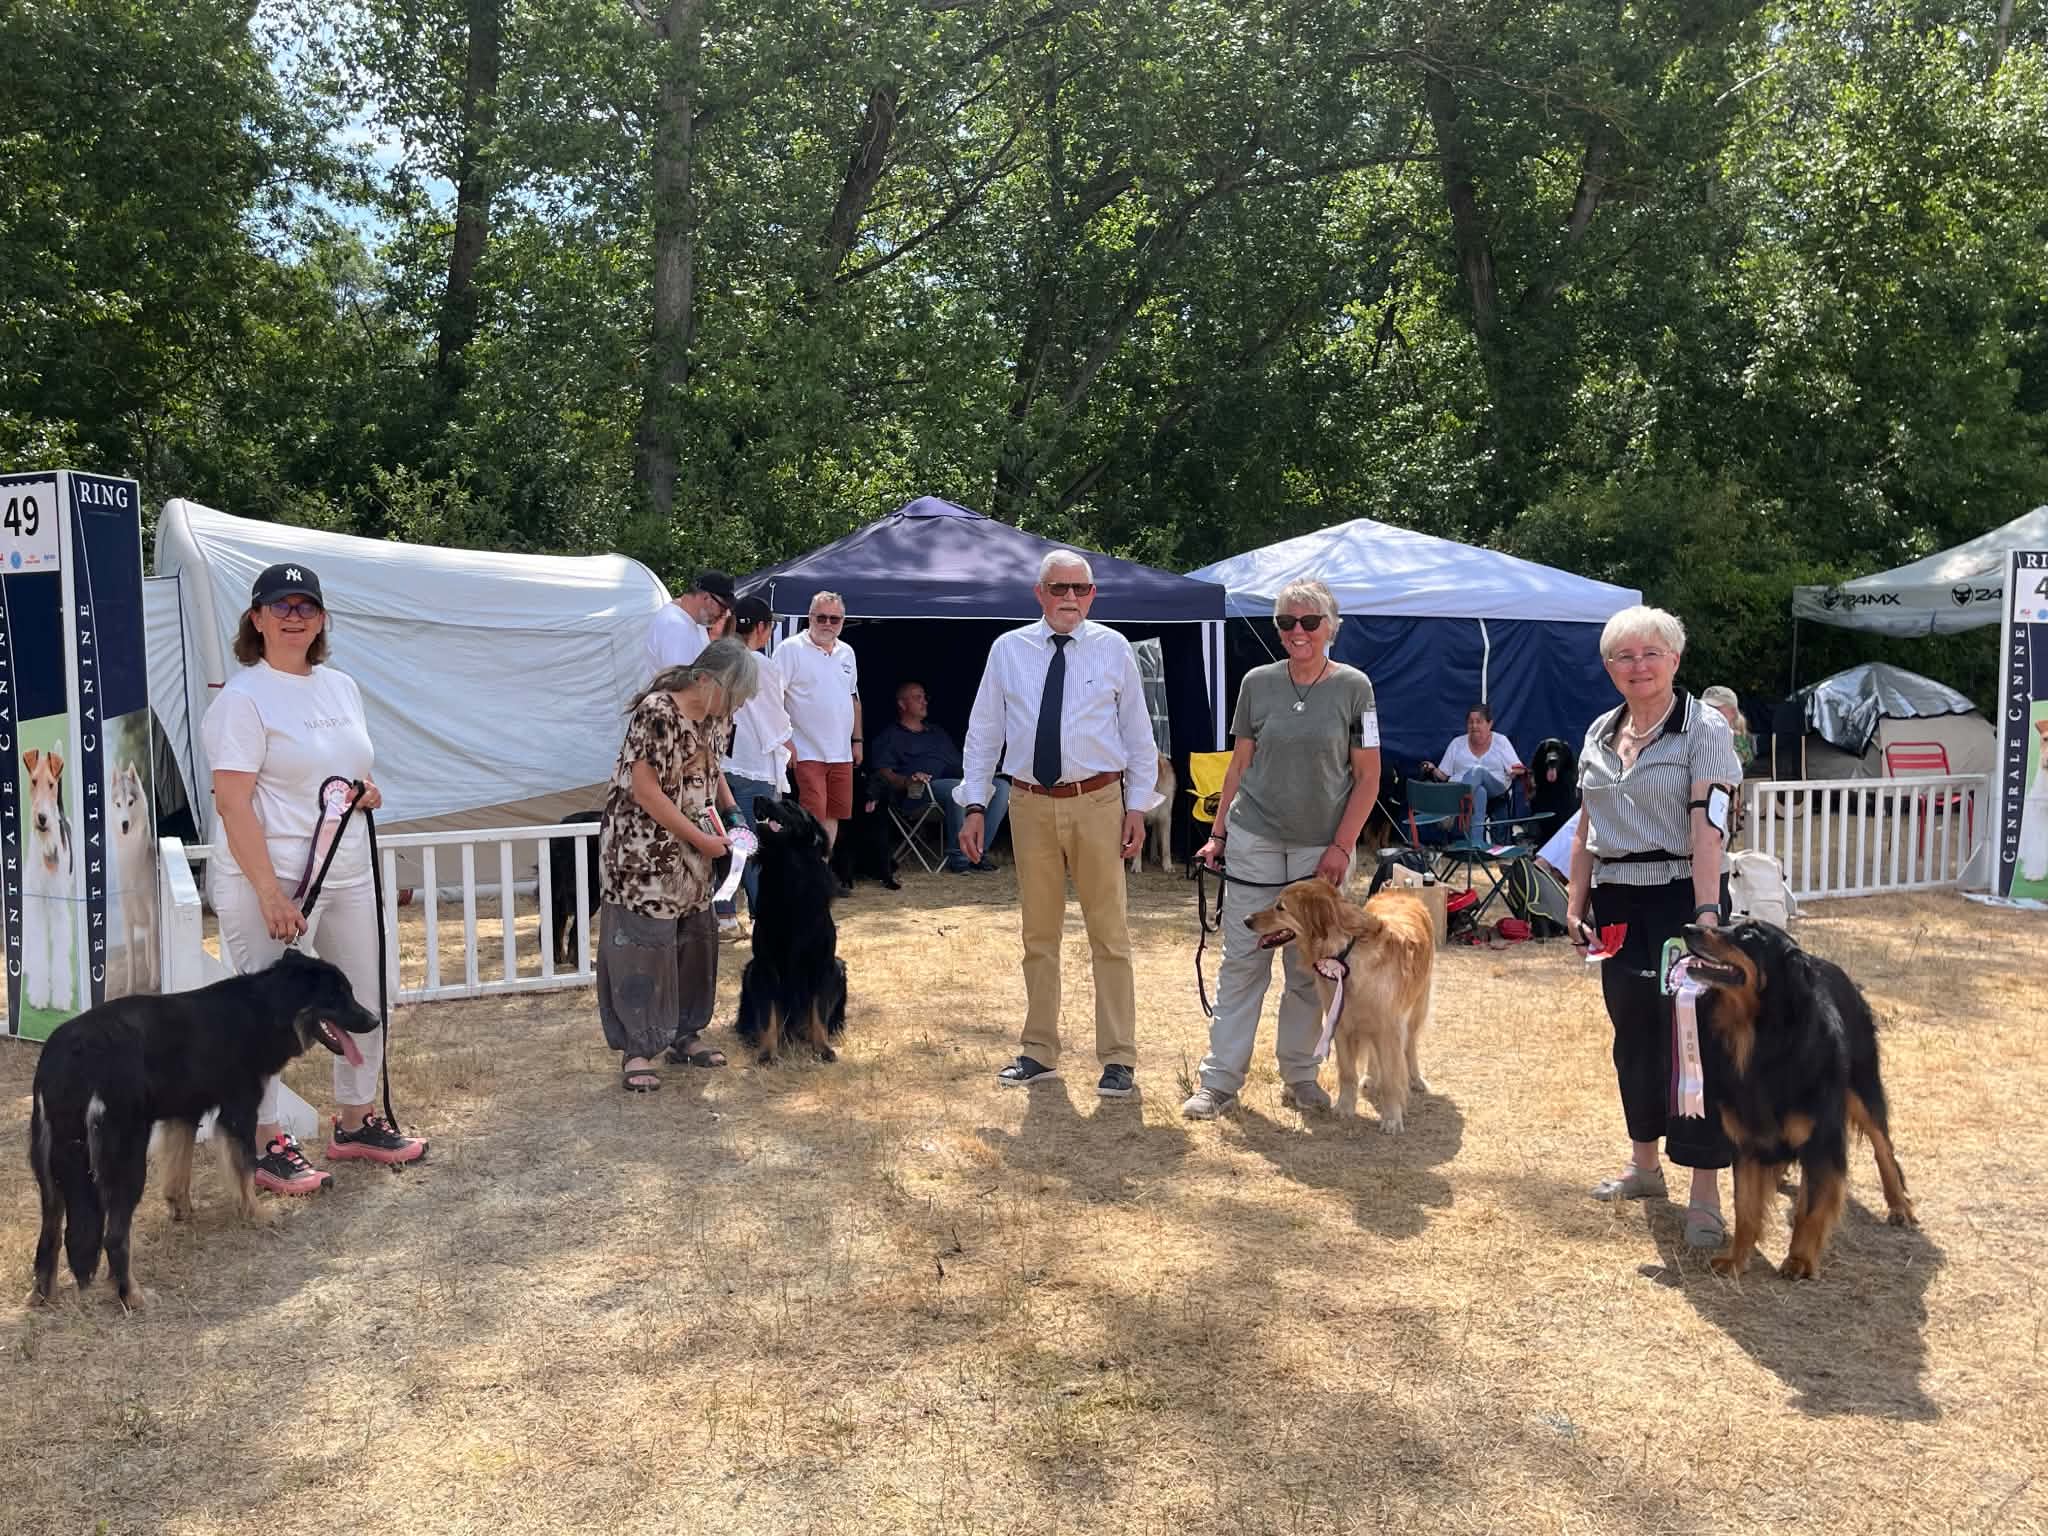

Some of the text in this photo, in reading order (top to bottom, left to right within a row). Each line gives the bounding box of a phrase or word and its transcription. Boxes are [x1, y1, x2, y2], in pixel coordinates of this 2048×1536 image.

[4, 496, 39, 536] 49
[79, 481, 128, 508] RING
[80, 604, 104, 982] CENTRALE CANINE
[2003, 629, 2025, 863] CENTRALE CANINE
[3, 781, 21, 977] CENTRALE
